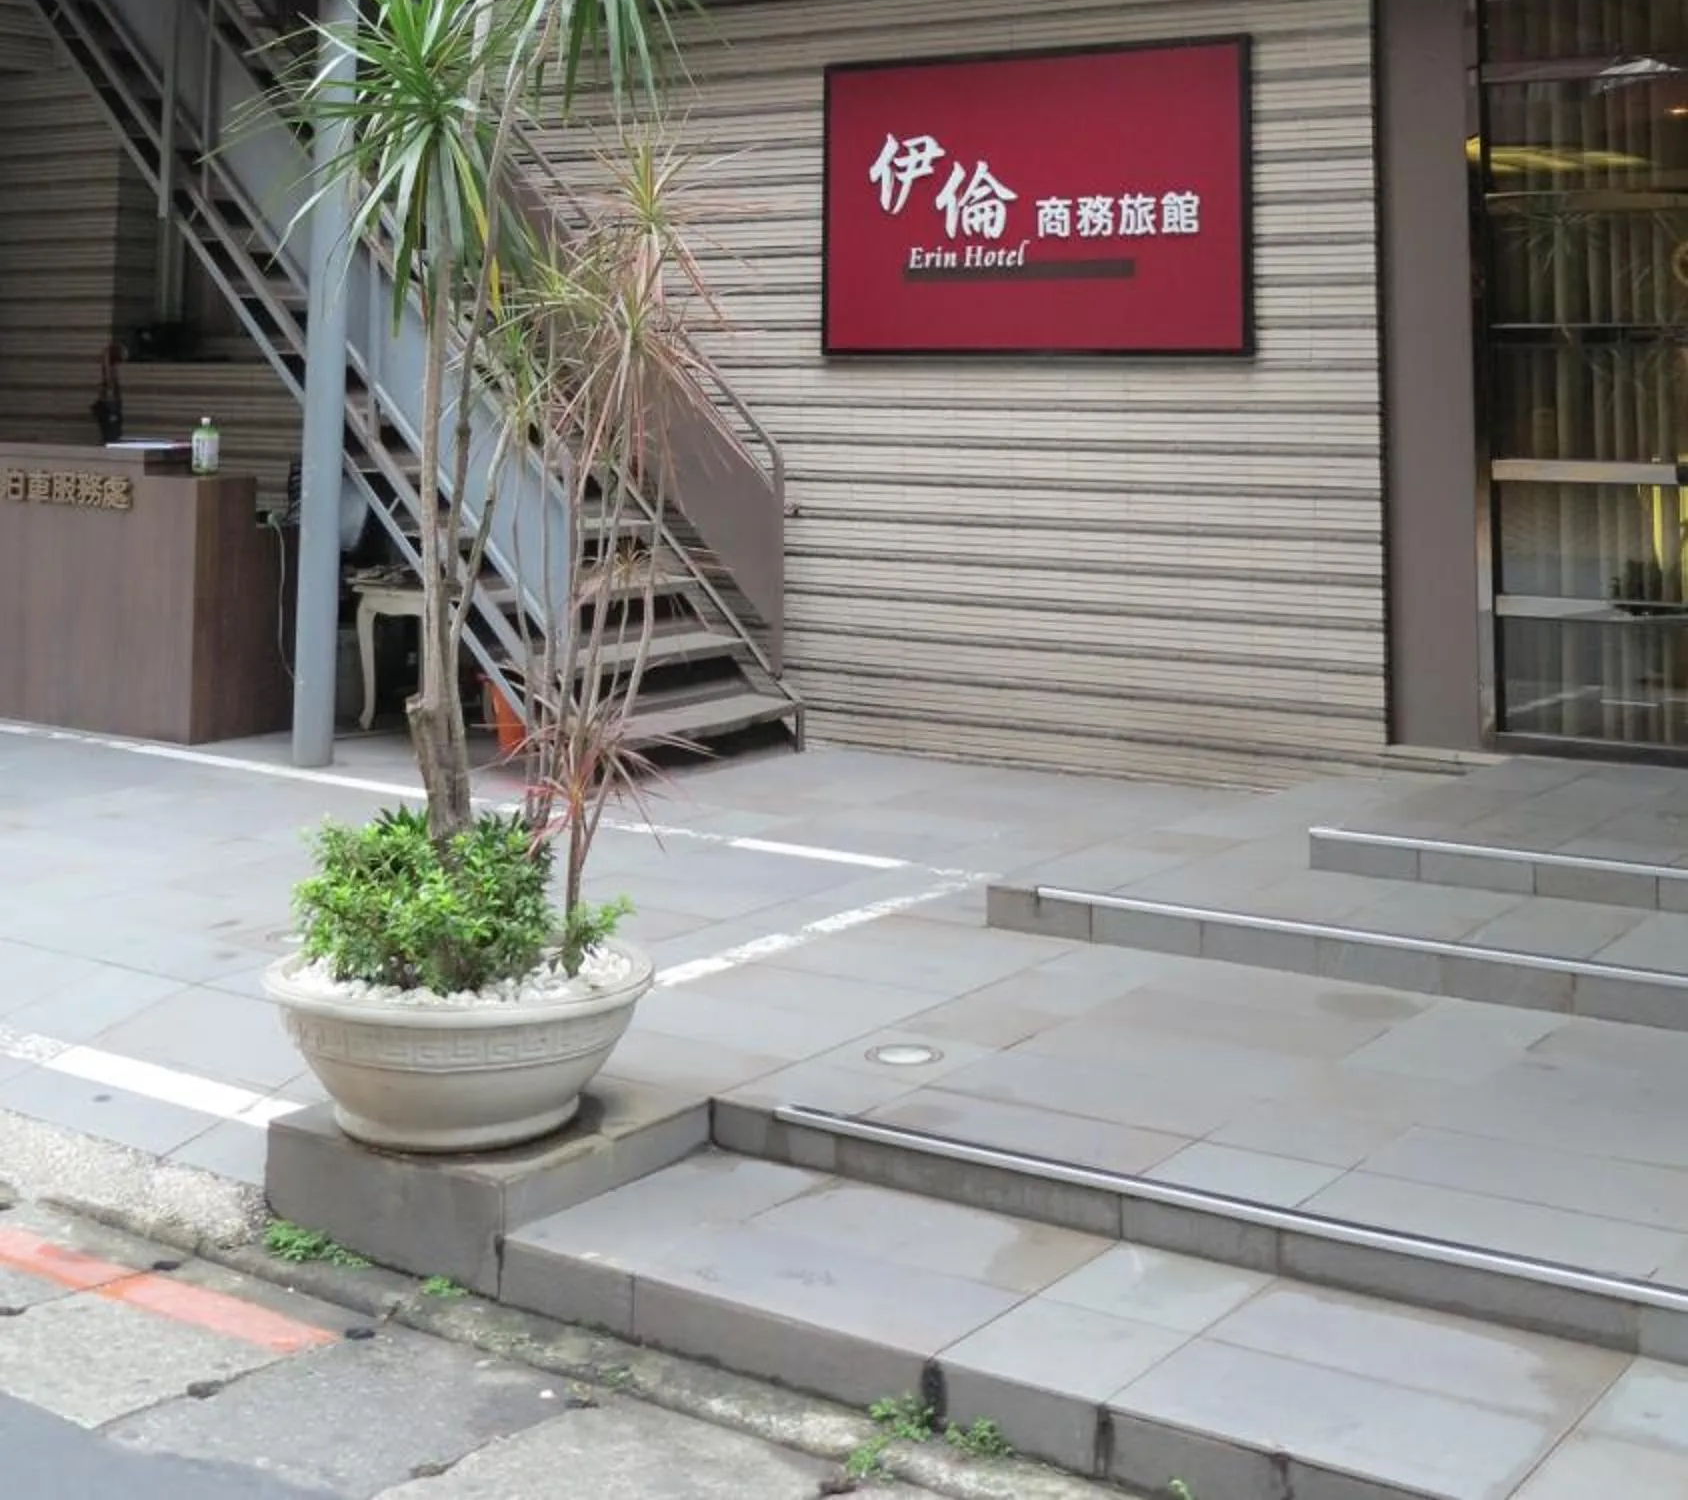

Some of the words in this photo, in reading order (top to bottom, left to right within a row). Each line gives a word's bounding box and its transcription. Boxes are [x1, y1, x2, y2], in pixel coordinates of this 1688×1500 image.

[869, 133, 1018, 239] 伊倫
[1035, 191, 1200, 238] 商務旅館
[909, 246, 957, 269] Erin
[963, 239, 1031, 268] Hotel
